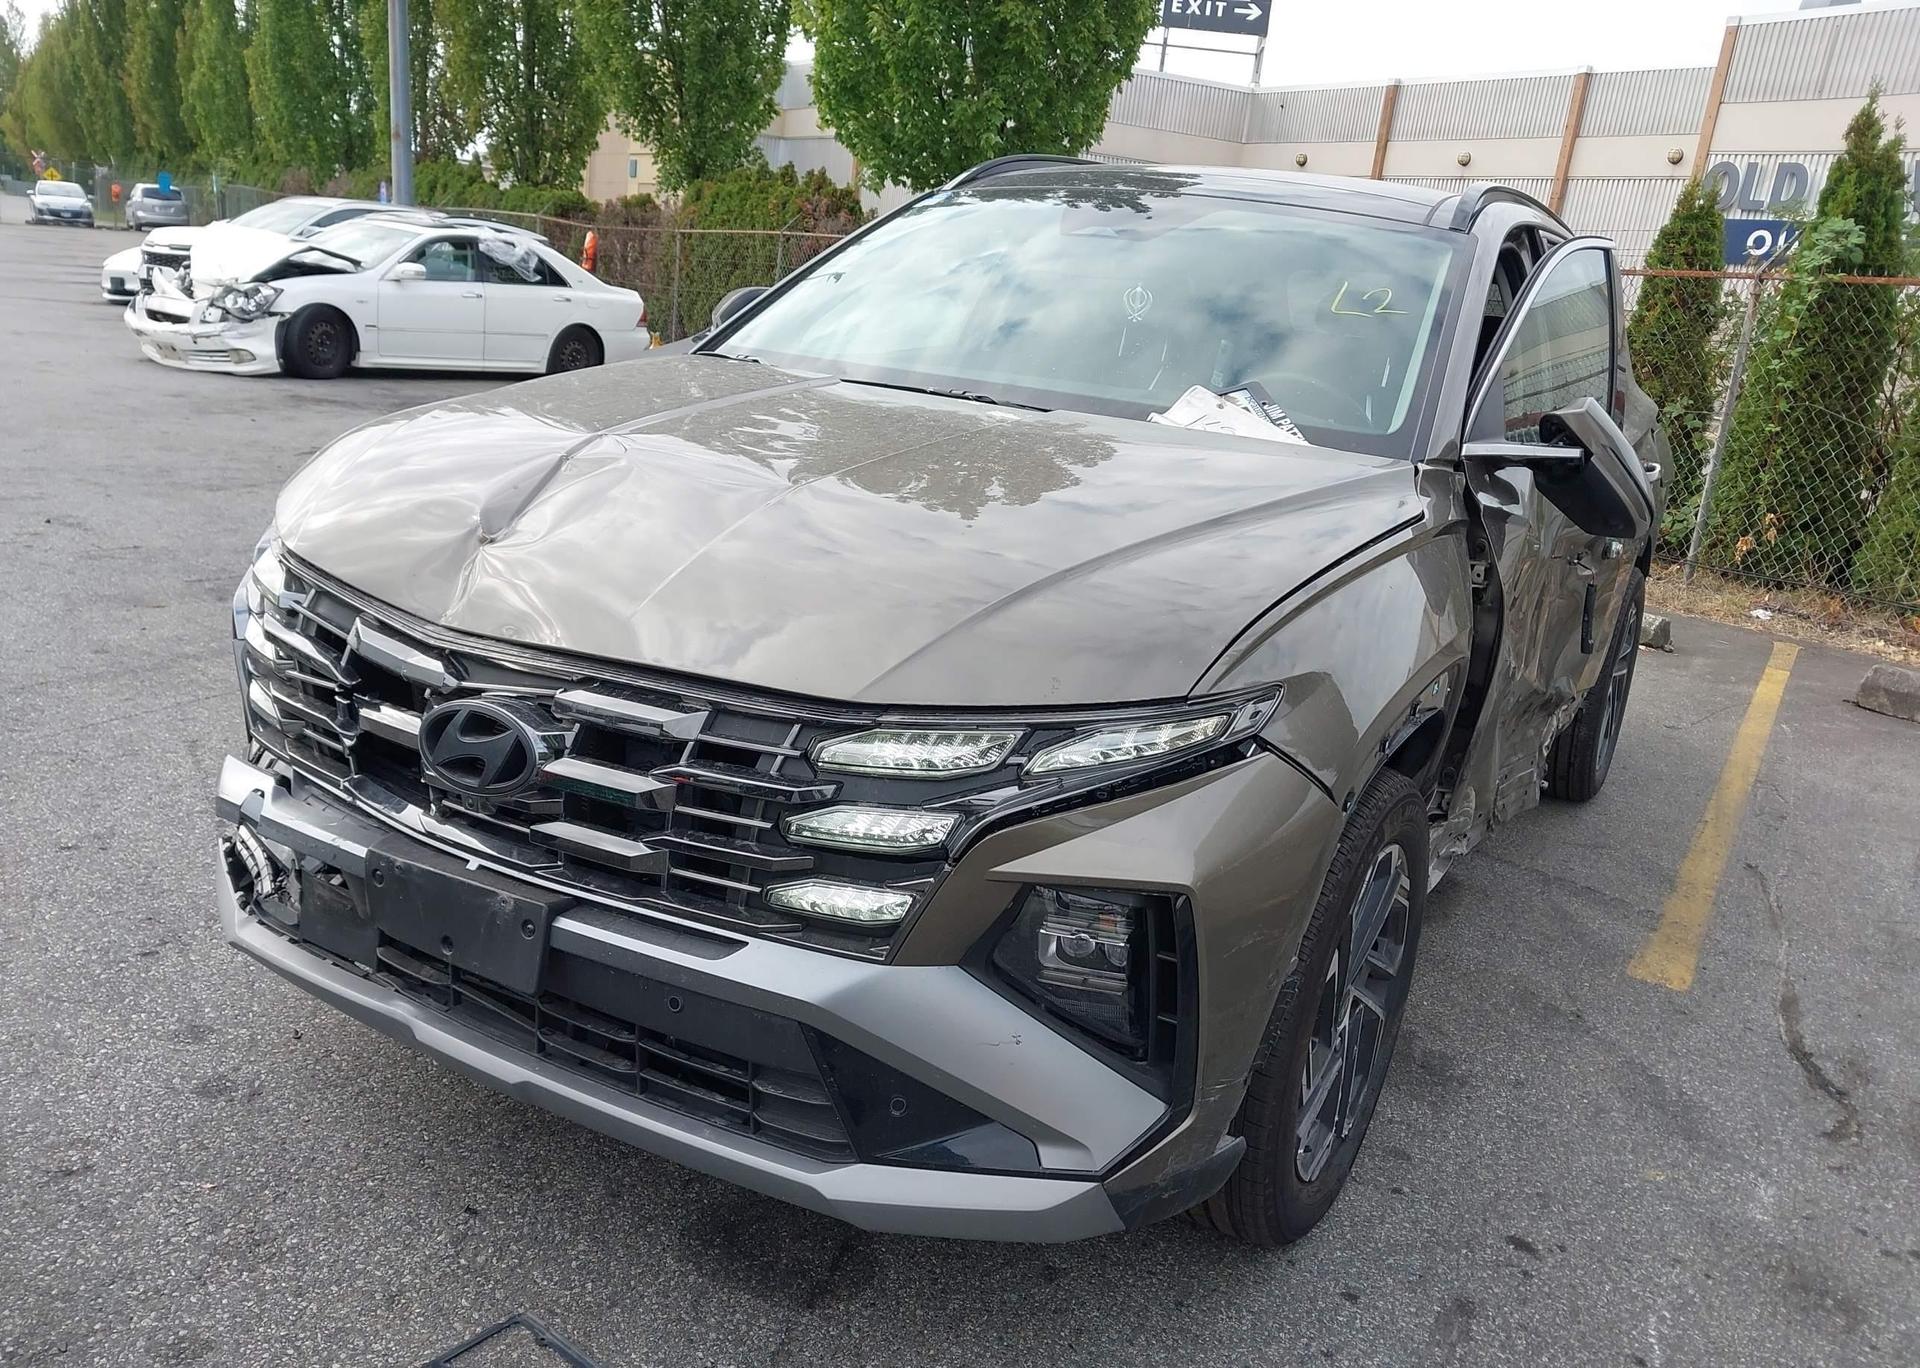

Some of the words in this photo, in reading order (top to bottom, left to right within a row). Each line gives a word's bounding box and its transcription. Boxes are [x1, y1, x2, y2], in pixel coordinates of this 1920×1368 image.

[1171, 0, 1227, 17] EXIT
[1703, 161, 1809, 211] OLD
[1330, 281, 1408, 317] L2
[1263, 404, 1286, 420] JIM
